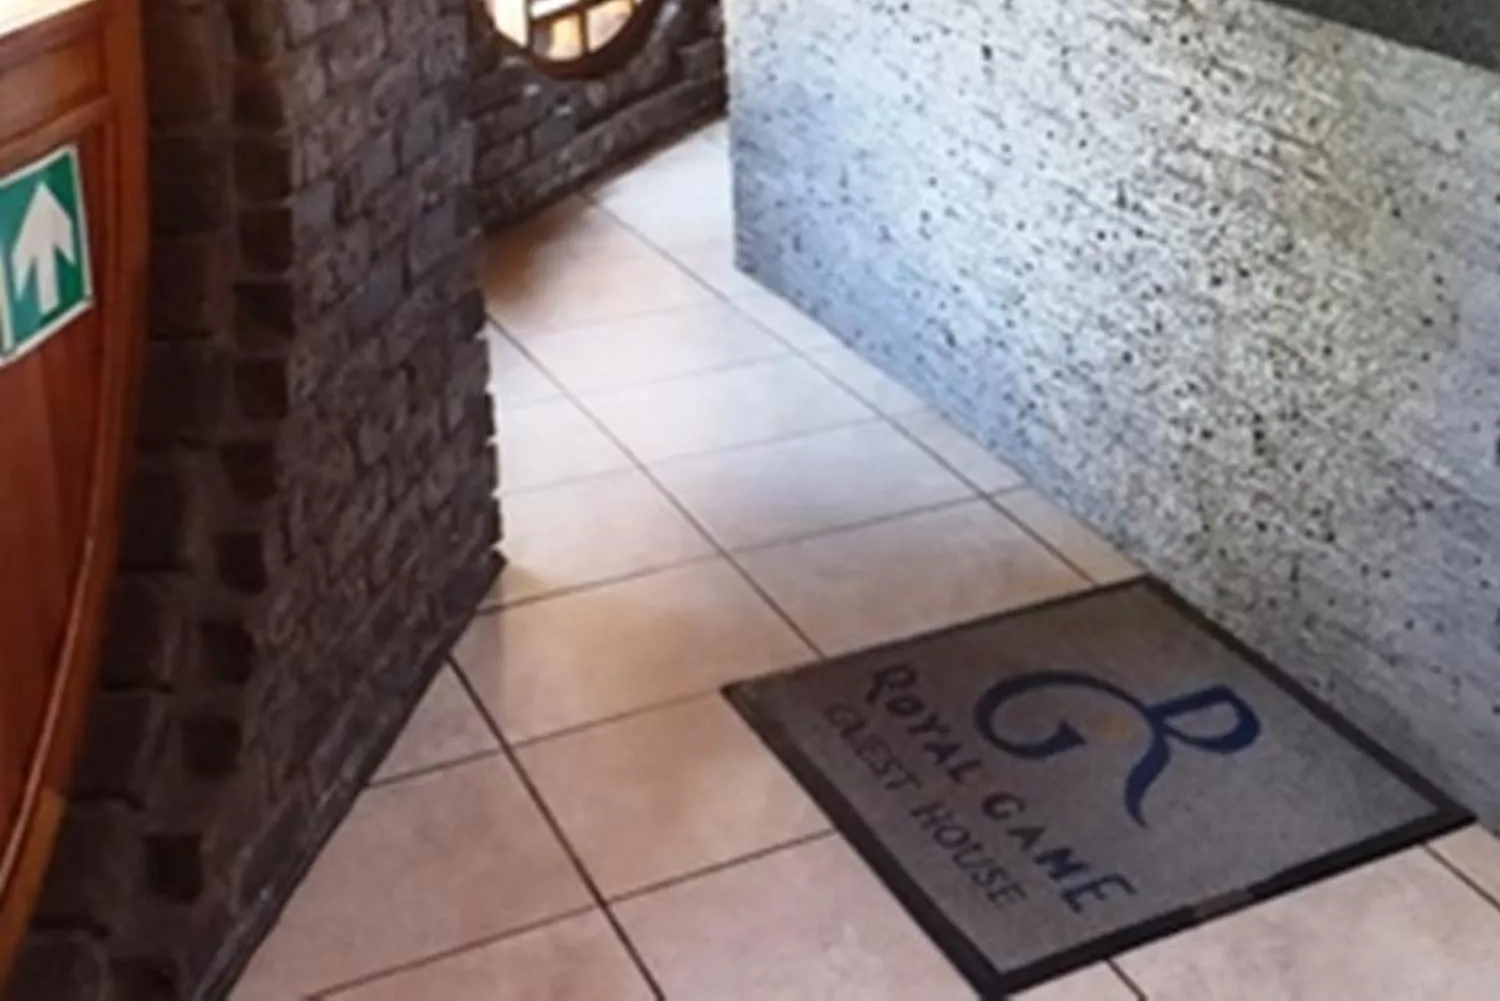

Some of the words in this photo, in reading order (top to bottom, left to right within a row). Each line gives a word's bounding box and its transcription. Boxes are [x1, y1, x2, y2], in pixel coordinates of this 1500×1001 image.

[828, 707, 919, 791] GUEST
[911, 802, 1028, 910] HOUSE
[868, 664, 981, 785] ROYAL
[983, 792, 1137, 914] GAME
